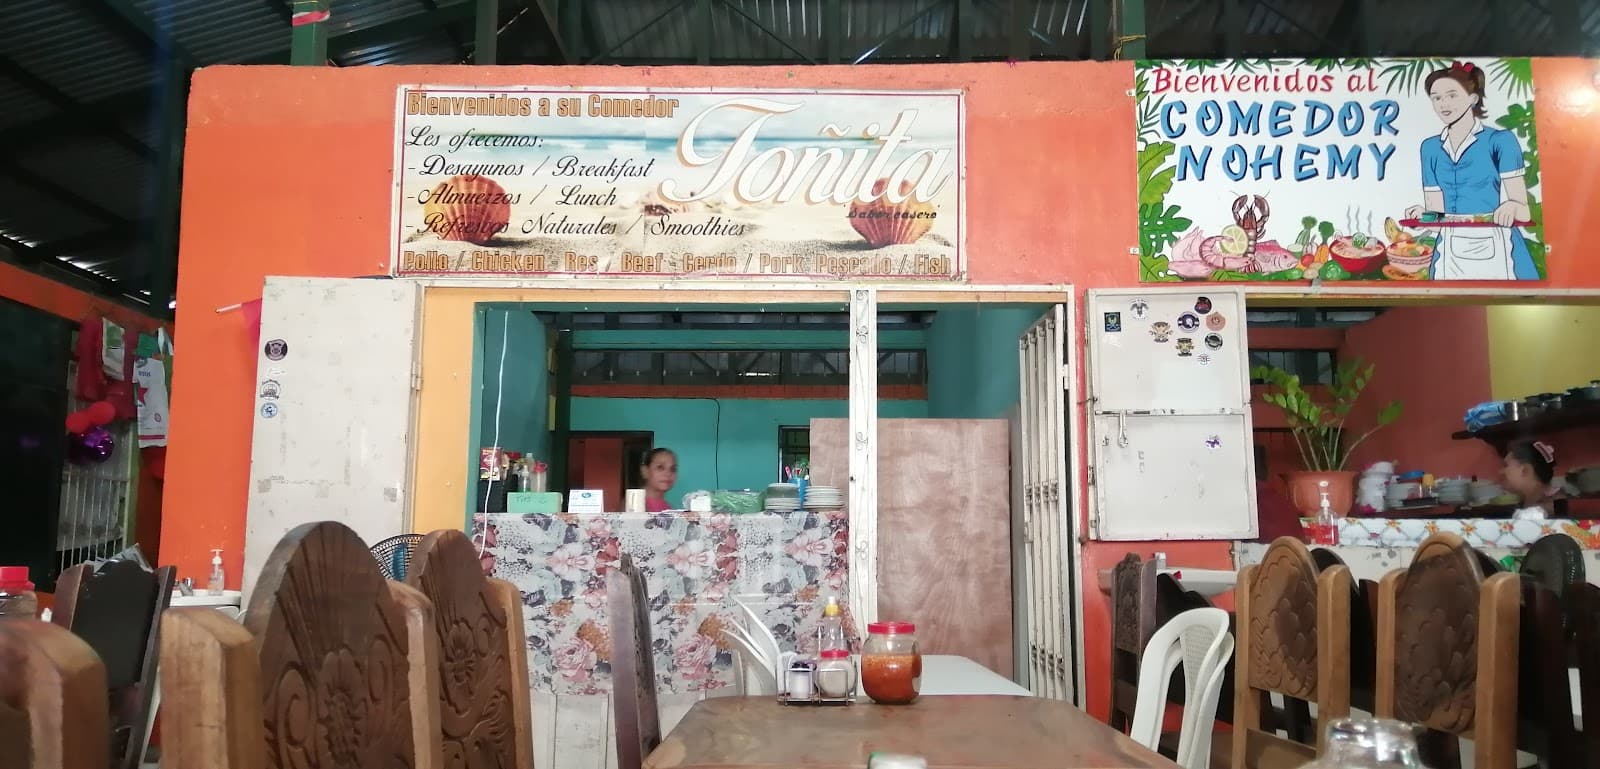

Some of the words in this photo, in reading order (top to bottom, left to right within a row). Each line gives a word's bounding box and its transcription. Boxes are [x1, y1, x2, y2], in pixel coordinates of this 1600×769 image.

[1151, 67, 1335, 94] Bienvenidos
[1346, 68, 1380, 93] al
[407, 93, 531, 117] Bienvenidos
[538, 98, 551, 117] a
[556, 98, 581, 117] su
[587, 94, 679, 118] Comedor
[1160, 99, 1401, 139] COMEDOR
[405, 126, 440, 147] Les
[448, 128, 544, 153] ofrecemos:
[656, 96, 953, 205] Toñita
[552, 156, 656, 183] Breakfast
[1176, 142, 1397, 182] NOHEMY
[555, 185, 618, 206] Lunch
[521, 215, 617, 236] Naturales
[650, 215, 747, 236] Smoothies
[403, 251, 449, 272] Pollo
[471, 251, 546, 272] Chicken
[564, 252, 599, 272] Res
[621, 252, 664, 273] Beef
[682, 253, 737, 273] Cerdo
[760, 253, 804, 273] Pork
[815, 254, 892, 274] Pescado
[913, 255, 952, 274] Fish
